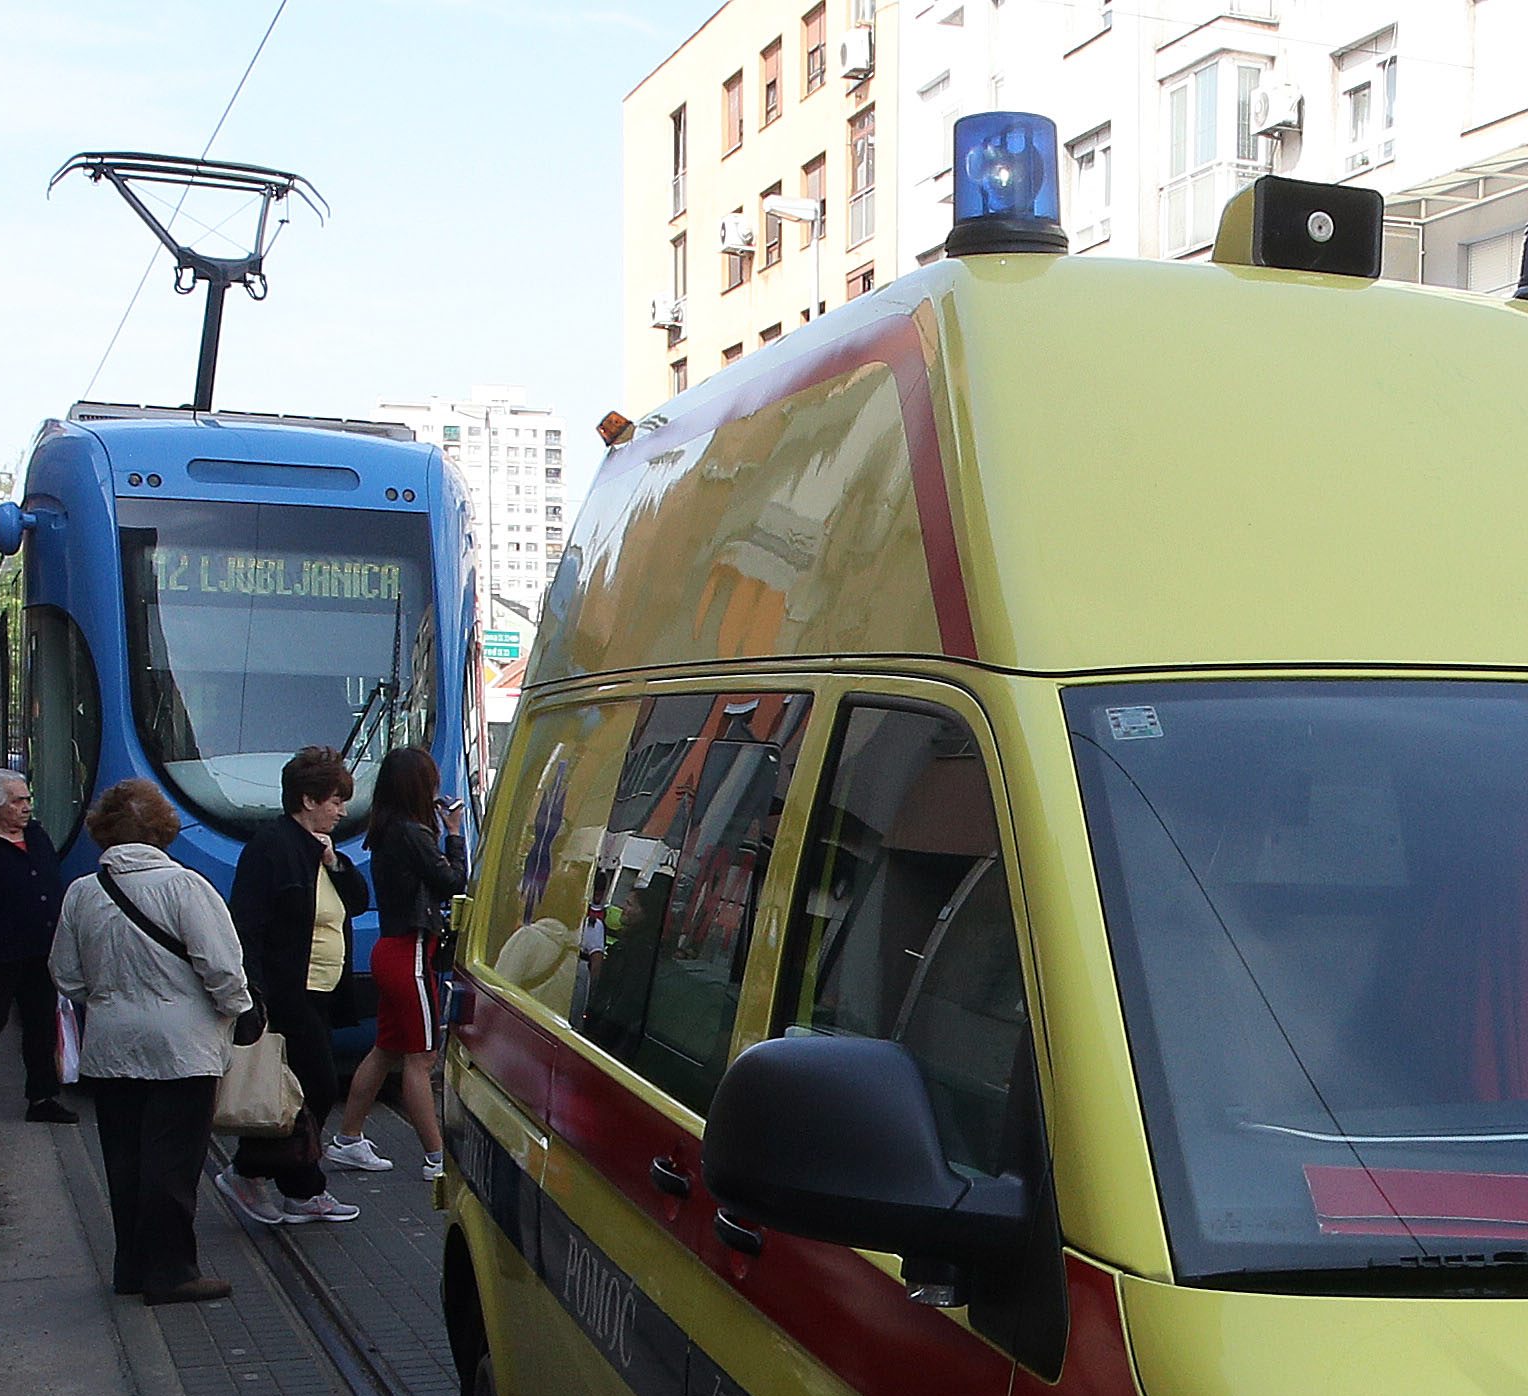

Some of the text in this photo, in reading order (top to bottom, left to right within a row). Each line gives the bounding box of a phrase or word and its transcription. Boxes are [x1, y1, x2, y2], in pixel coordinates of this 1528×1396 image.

[156, 555, 402, 600] 12 LJUBLJANICA
[563, 1233, 638, 1368] POMOĆ
